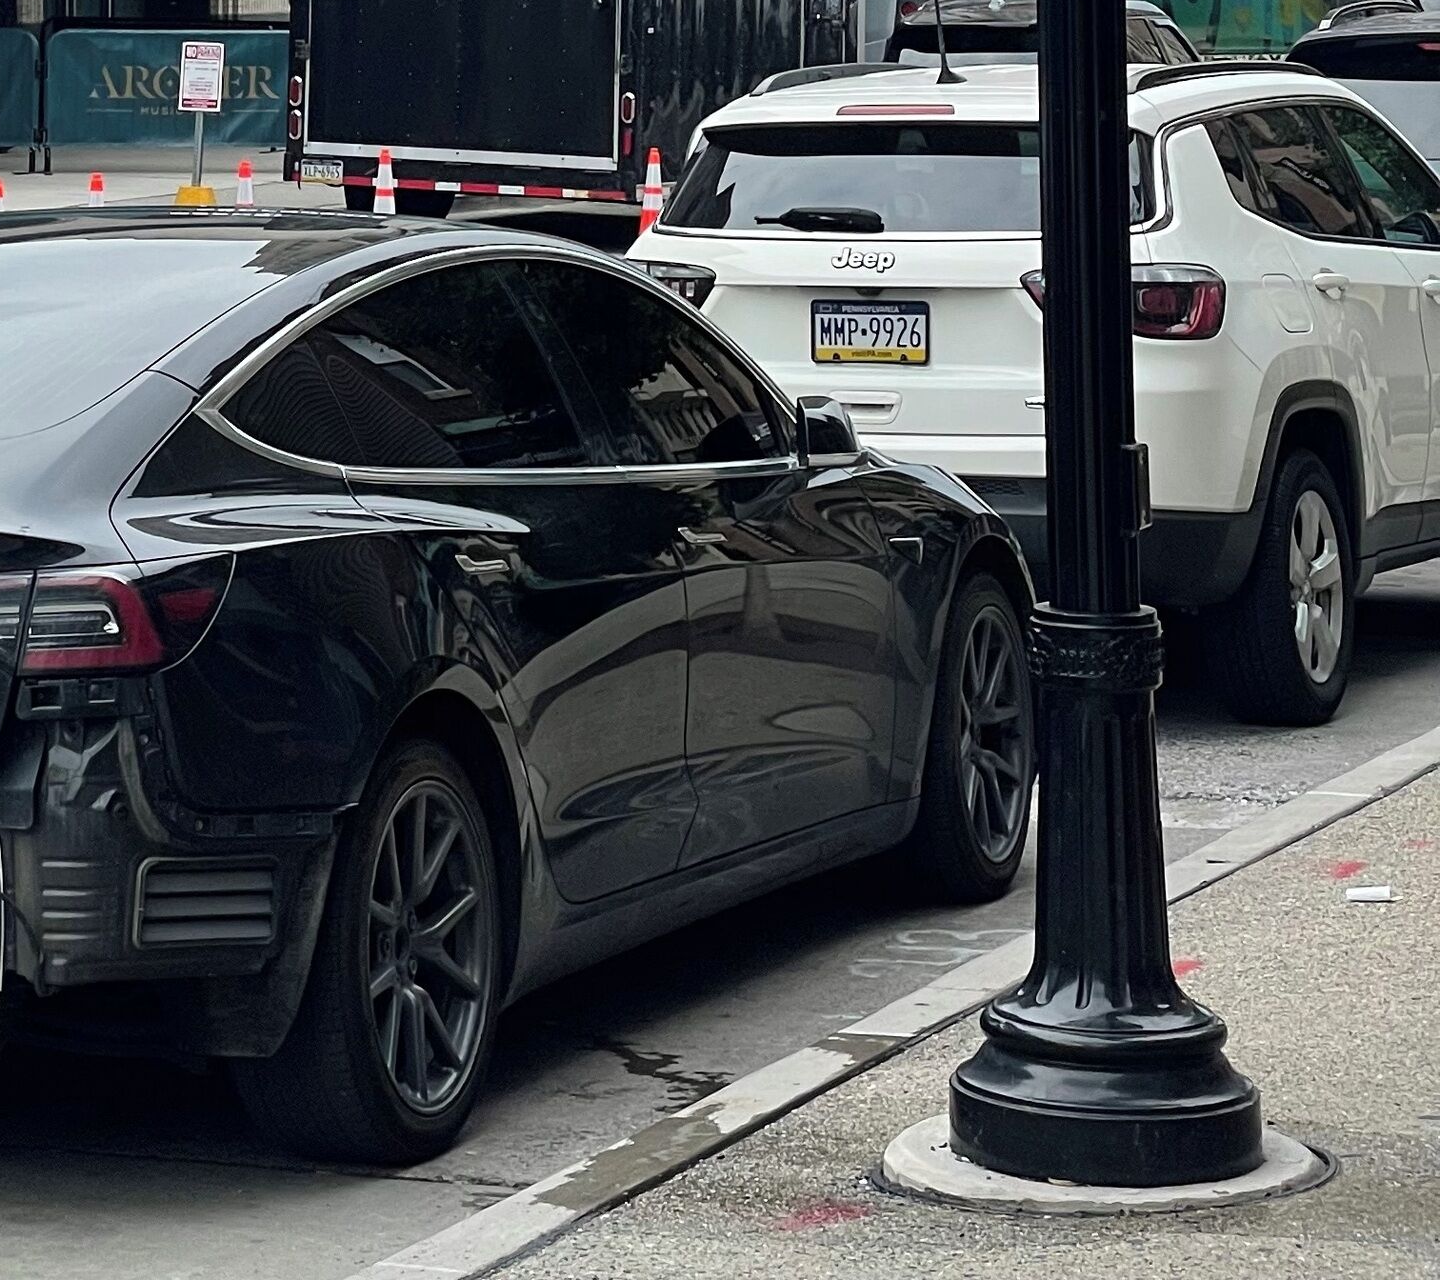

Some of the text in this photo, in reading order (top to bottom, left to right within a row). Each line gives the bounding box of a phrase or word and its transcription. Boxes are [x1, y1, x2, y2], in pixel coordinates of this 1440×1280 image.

[89, 63, 280, 100] ARCER
[831, 247, 896, 273] Jeep
[841, 305, 900, 313] PENNSYLVANIA
